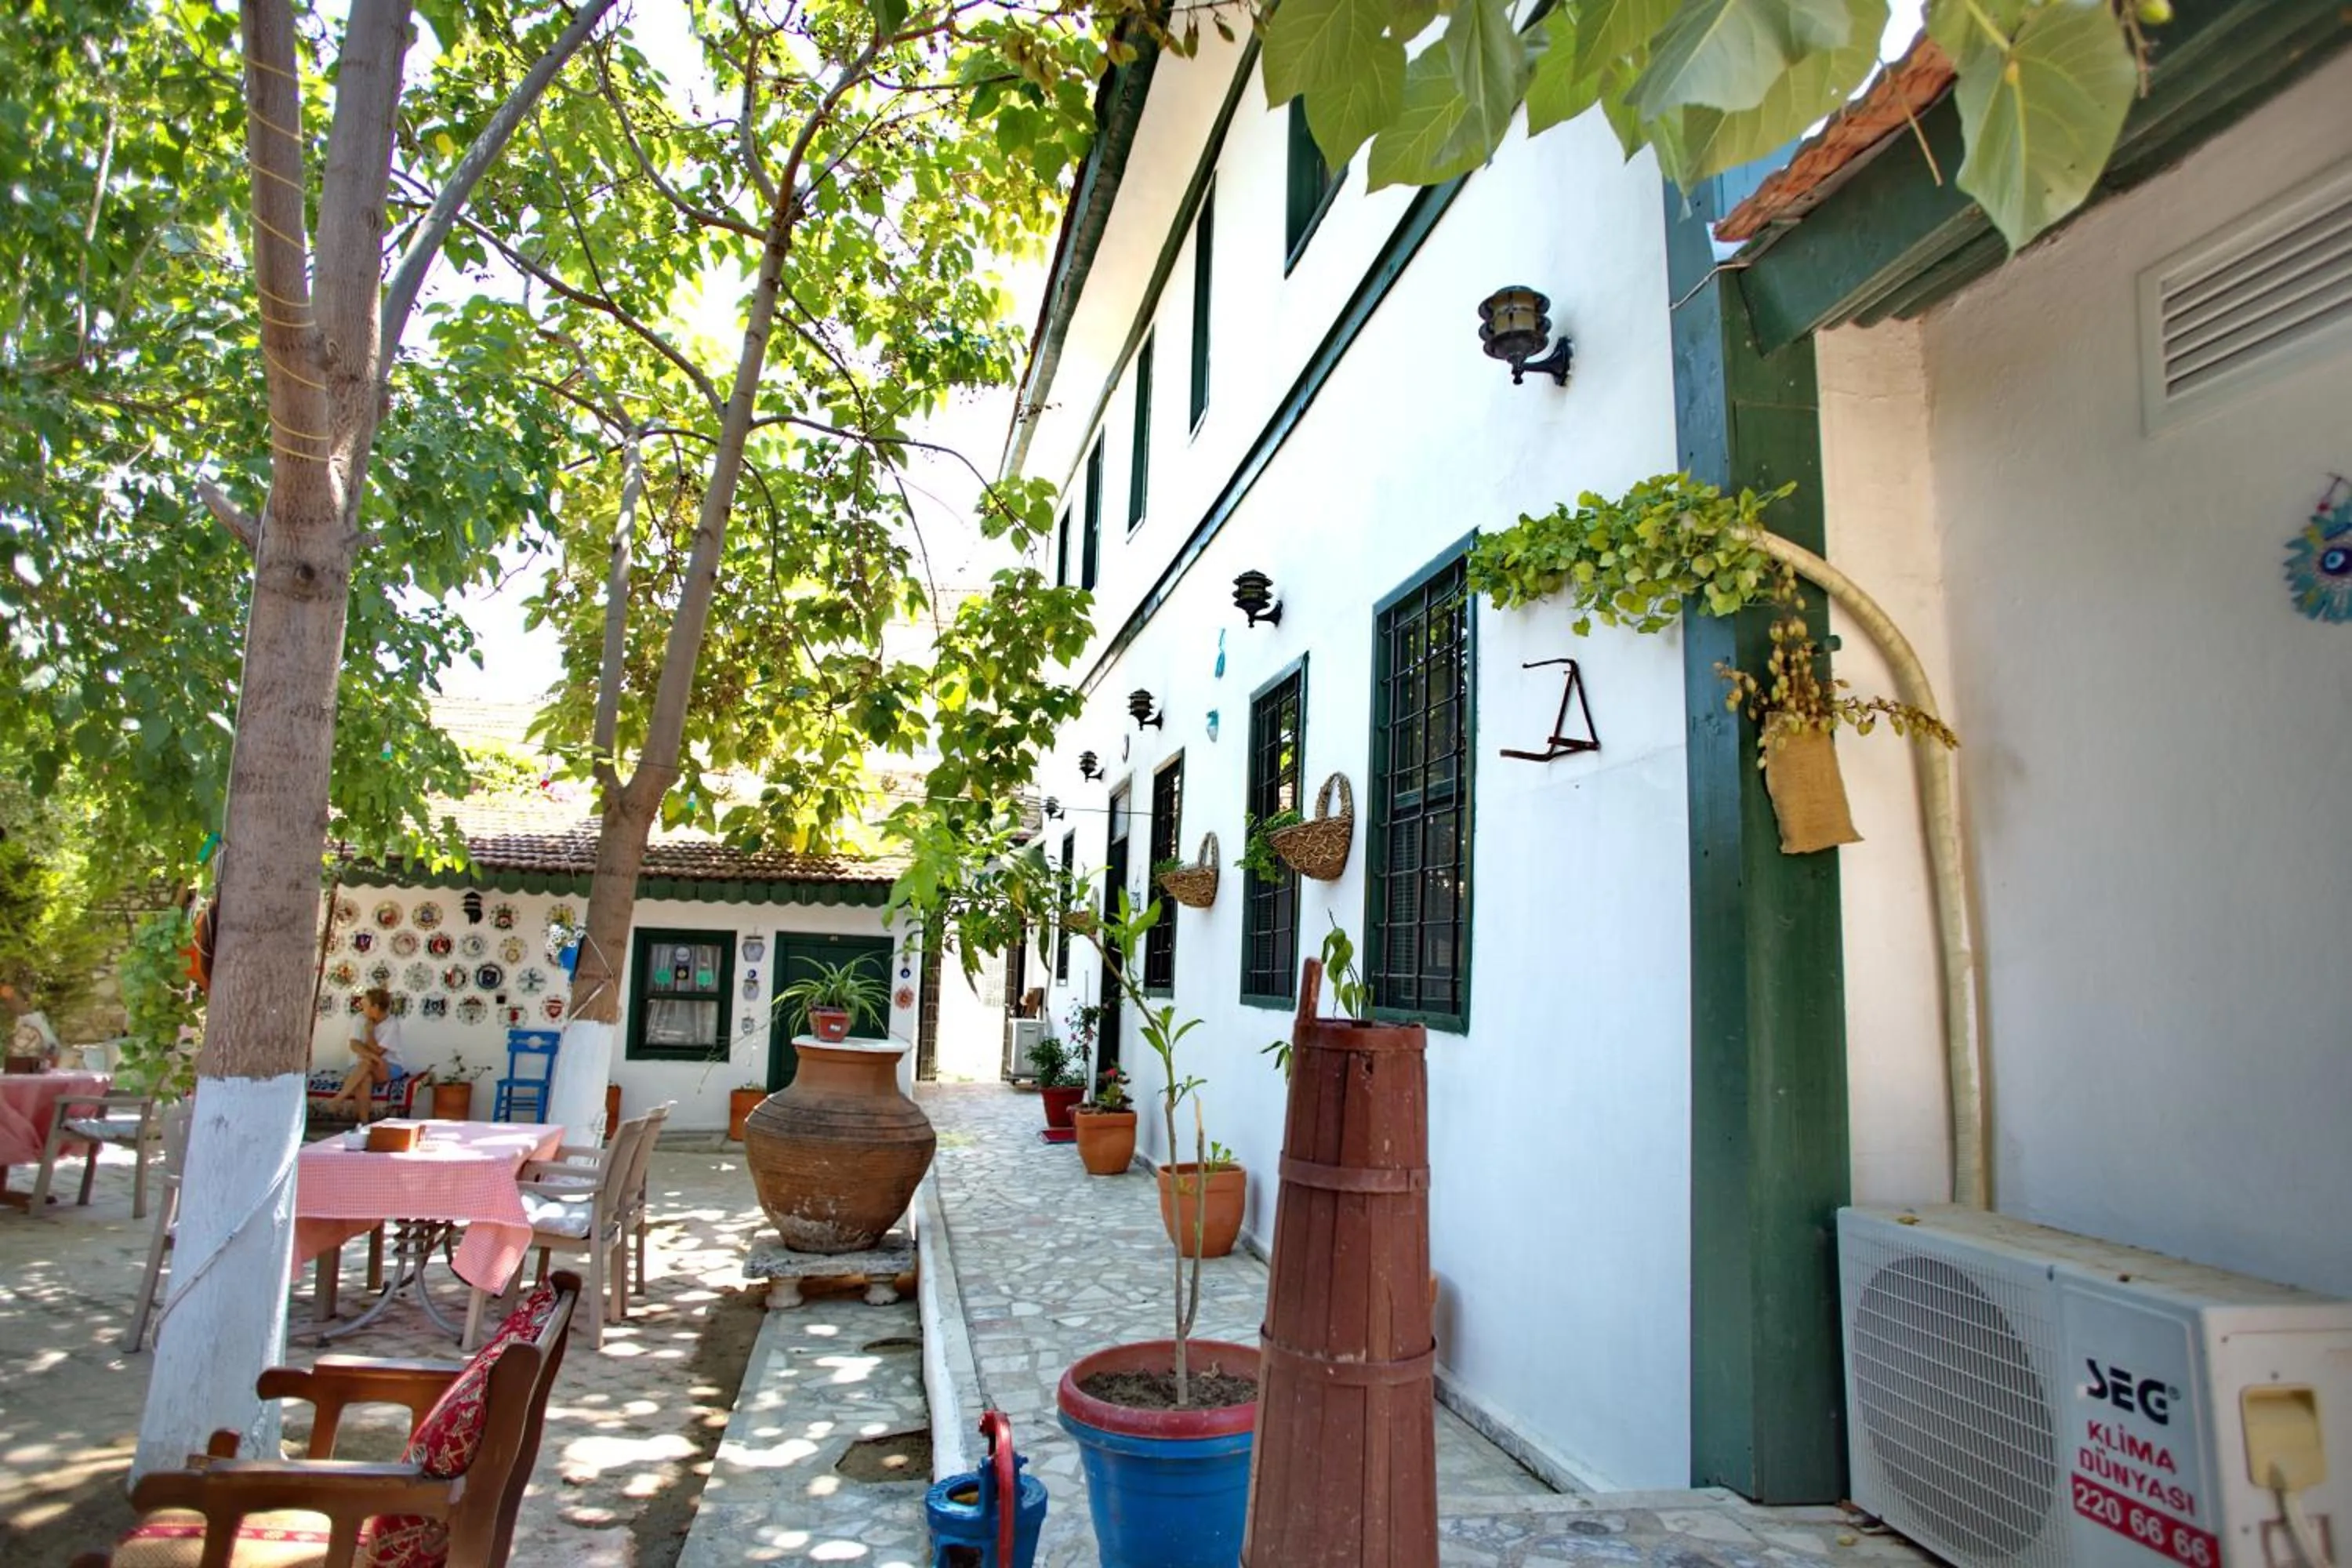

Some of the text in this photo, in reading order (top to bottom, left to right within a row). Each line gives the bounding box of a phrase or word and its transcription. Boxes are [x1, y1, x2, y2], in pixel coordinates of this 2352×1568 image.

[2086, 1358, 2169, 1425] SEG
[2079, 1446, 2195, 1517] DÜNYASI
[2087, 1420, 2176, 1475] KLİMA
[2075, 1483, 2211, 1566] 220 66 66
